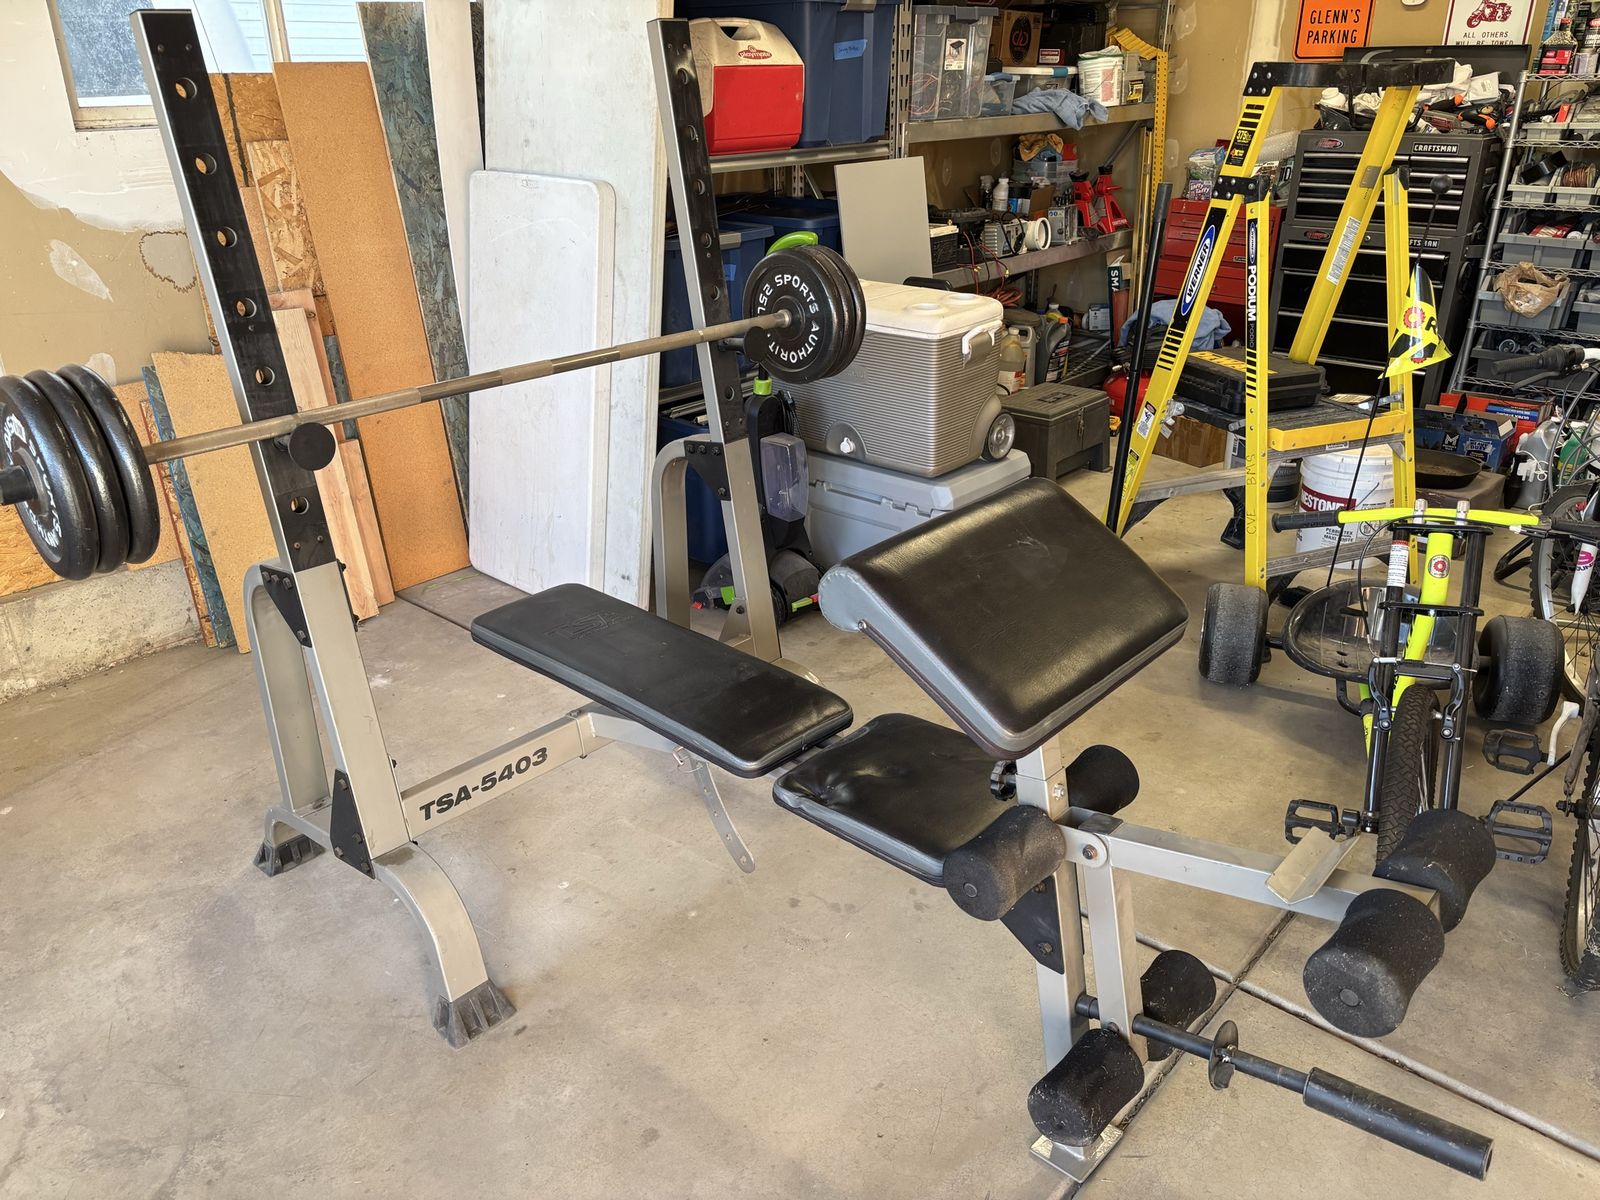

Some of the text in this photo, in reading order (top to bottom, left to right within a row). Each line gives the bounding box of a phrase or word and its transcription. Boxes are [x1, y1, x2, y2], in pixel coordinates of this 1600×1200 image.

[1309, 8, 1361, 25] GLENN'S
[1306, 29, 1358, 45] PARKING
[1462, 31, 1509, 39] ALL OTHERS
[1413, 144, 1458, 153] CRAFTSMAN
[1409, 239, 1439, 247] FTSAN
[1187, 243, 1210, 298] WERNER
[1247, 265, 1257, 322] PODIUM
[767, 274, 821, 364] SPORTS AUTHORIT
[419, 746, 549, 821] TSA-5403
